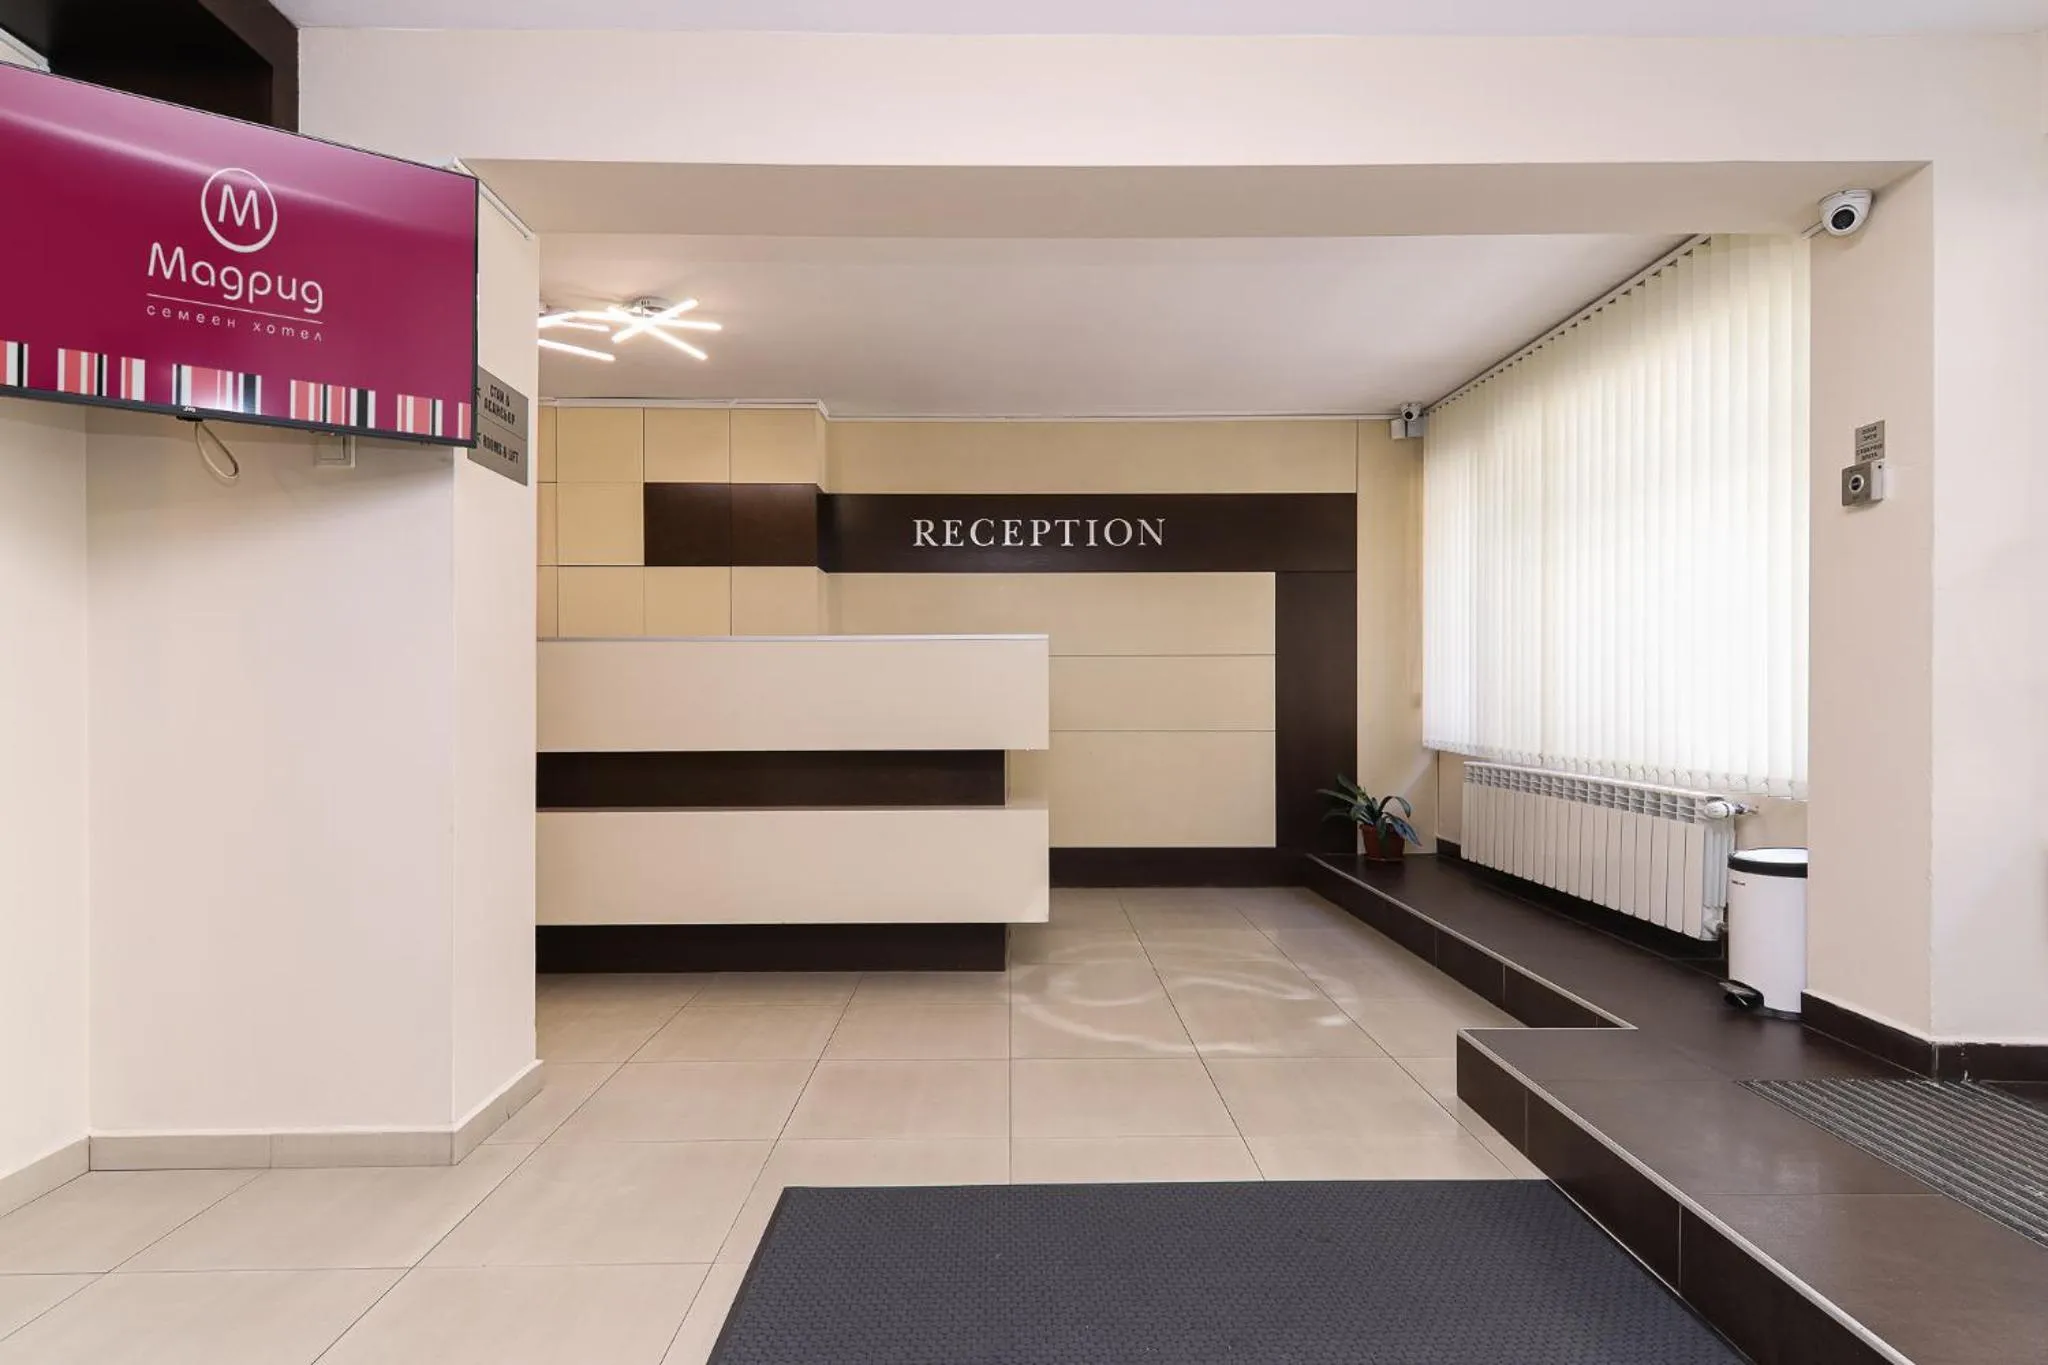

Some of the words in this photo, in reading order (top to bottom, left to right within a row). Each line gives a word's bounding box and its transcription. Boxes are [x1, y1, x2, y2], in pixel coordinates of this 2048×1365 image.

[146, 305, 236, 328] семеен
[252, 322, 322, 342] хотел
[912, 518, 1166, 547] RECEPTION
